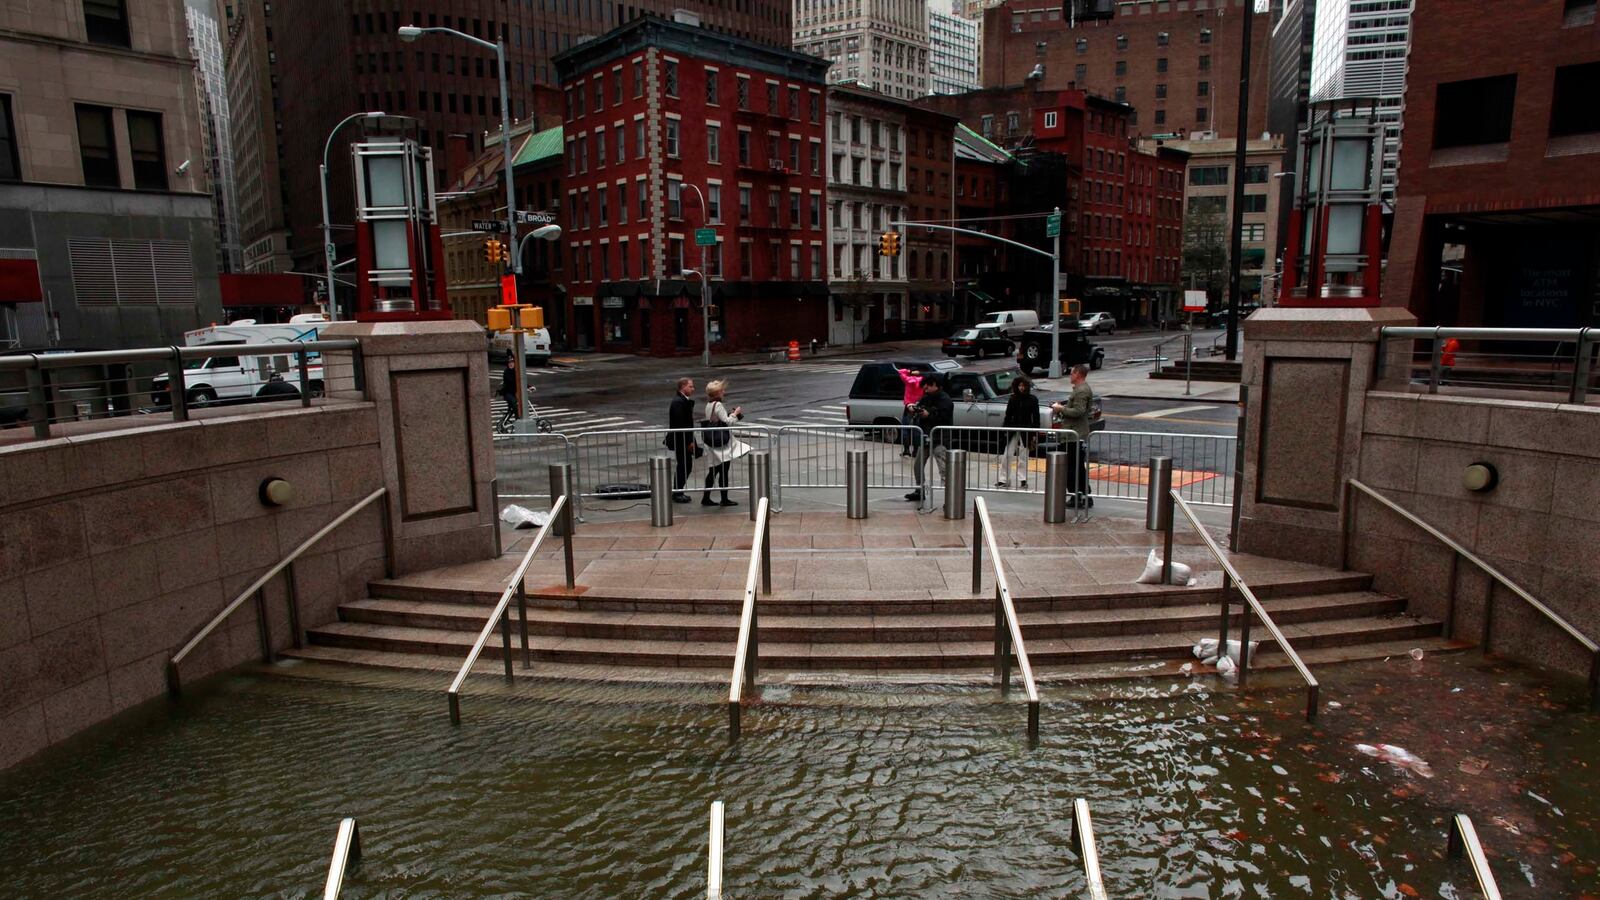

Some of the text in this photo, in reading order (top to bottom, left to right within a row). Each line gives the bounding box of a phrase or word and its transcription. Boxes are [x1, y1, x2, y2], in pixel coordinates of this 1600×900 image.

[527, 214, 552, 223] BROAD
[473, 222, 492, 230] WATER
[1531, 278, 1557, 287] ATM
[1521, 287, 1568, 297] locations
[1522, 298, 1532, 307] in
